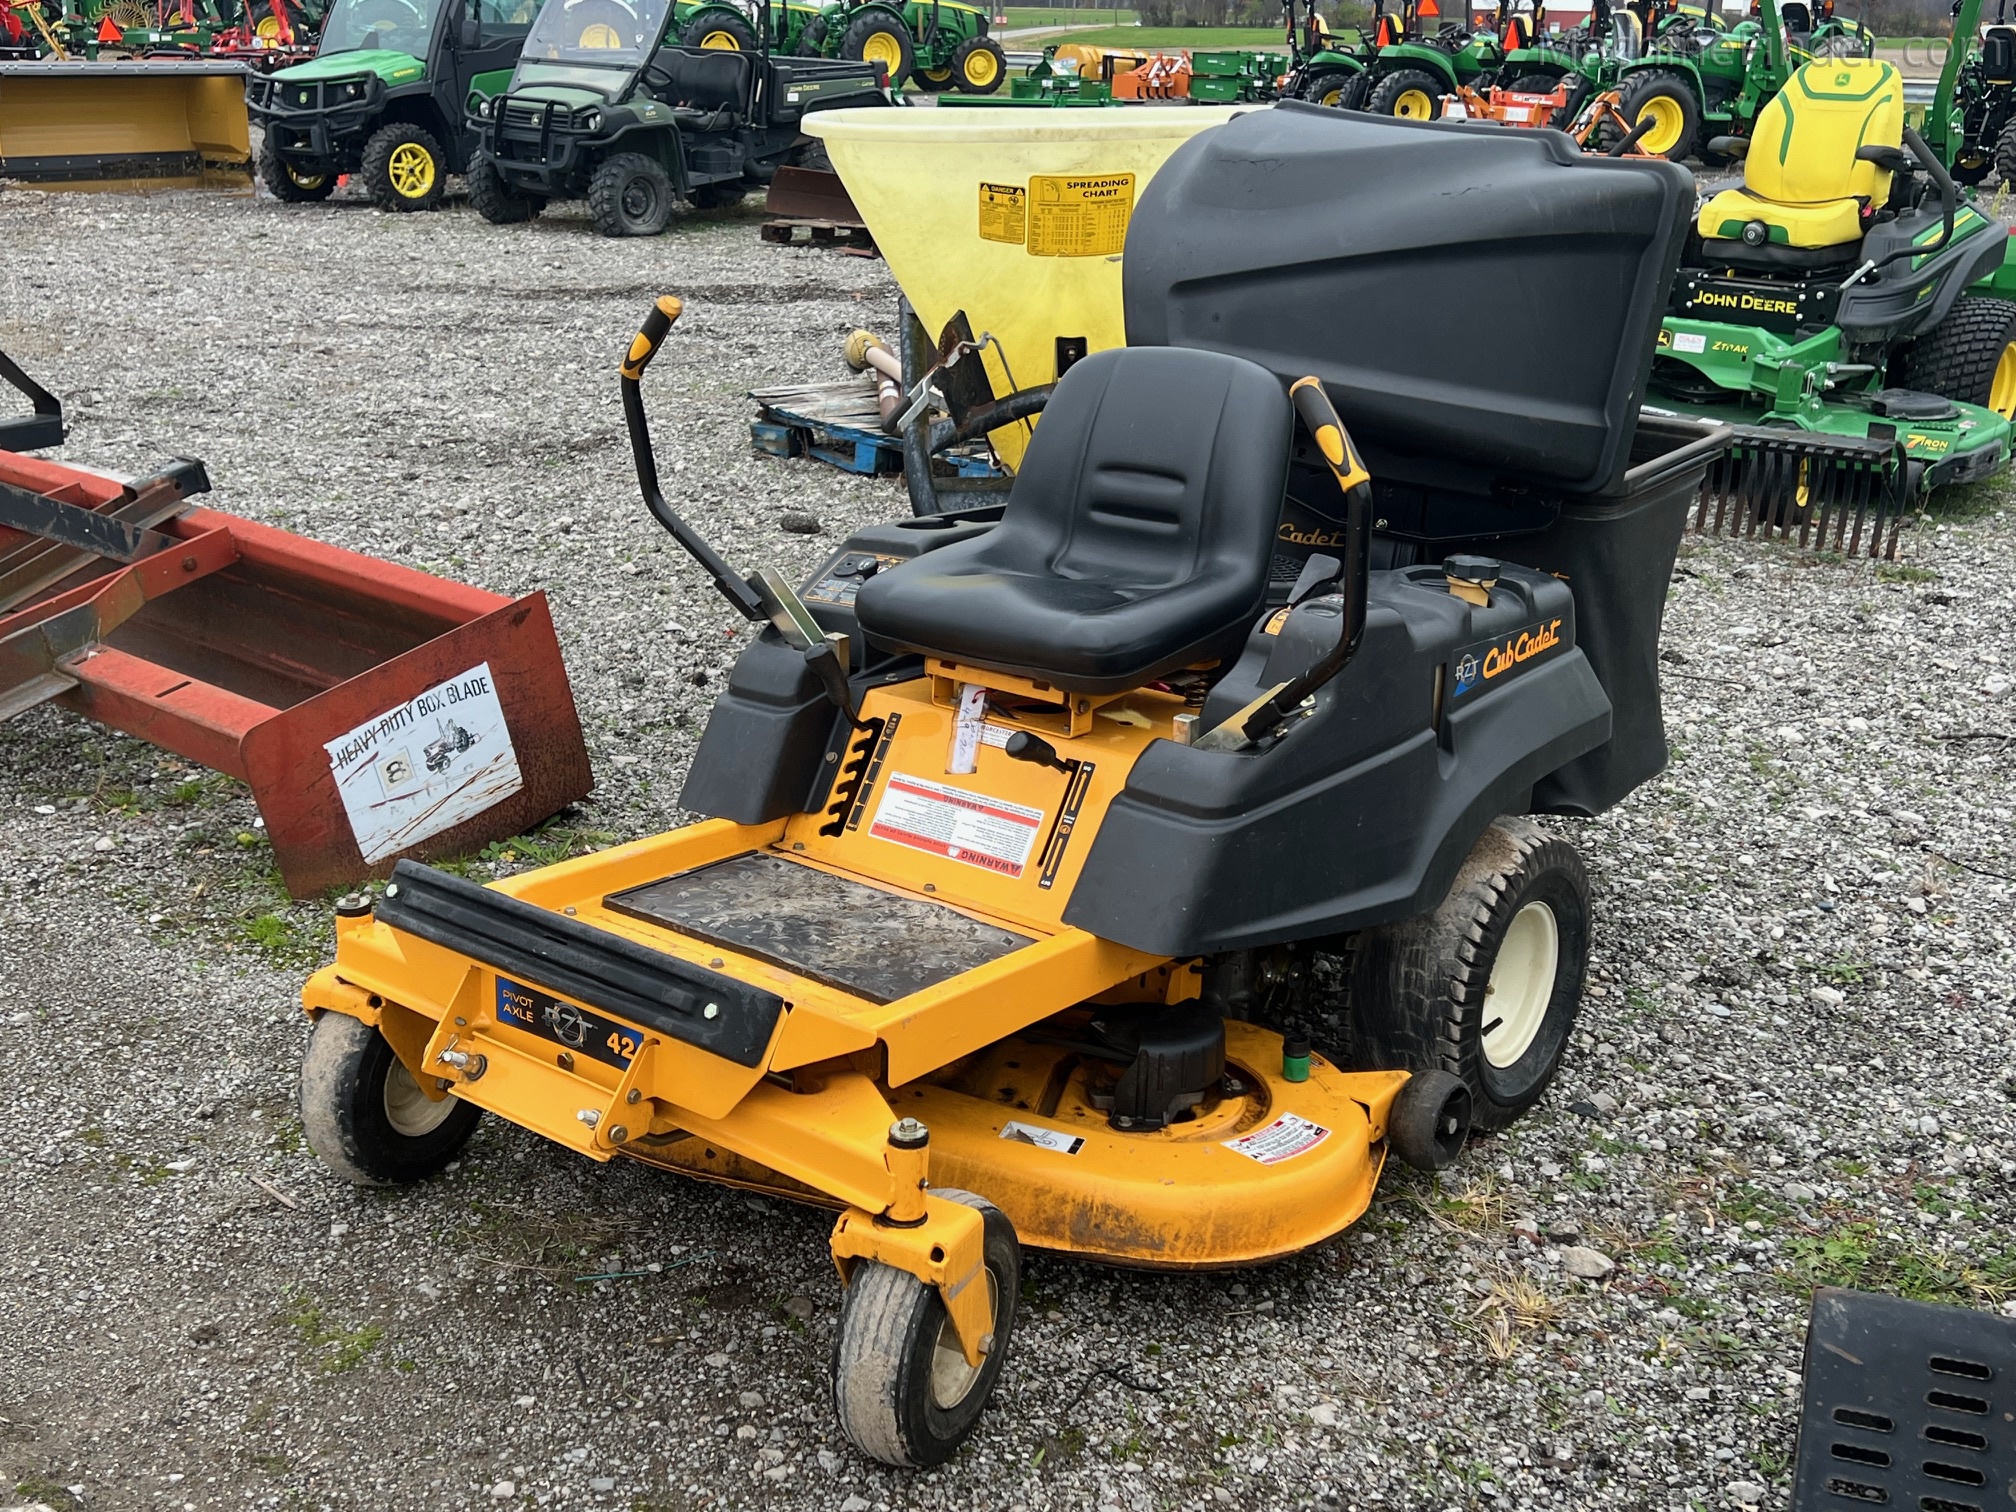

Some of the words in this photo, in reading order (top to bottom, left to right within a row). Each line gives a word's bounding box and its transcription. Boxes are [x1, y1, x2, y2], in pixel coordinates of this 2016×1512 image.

[990, 185, 1014, 195] DANGER
[1066, 178, 1130, 190] SPREADING
[1083, 189, 1119, 198] CHART
[1693, 290, 1737, 308] JOHN
[1740, 295, 1798, 314] DEERE
[1278, 523, 1347, 547] Cadet
[1455, 660, 1480, 681] RZT
[1482, 640, 1514, 679] Cub
[1514, 619, 1562, 663] Cadet
[336, 725, 378, 770] HEAVY
[380, 703, 415, 738] DUTY
[417, 690, 447, 718] BOX
[446, 676, 490, 704] BLADE
[943, 794, 979, 811] WARNING
[961, 849, 1009, 872] WARNING
[502, 989, 534, 1008] PIVOT
[502, 1003, 534, 1023] AXLE
[541, 1006, 594, 1042] RZT
[606, 1032, 636, 1060] 42
